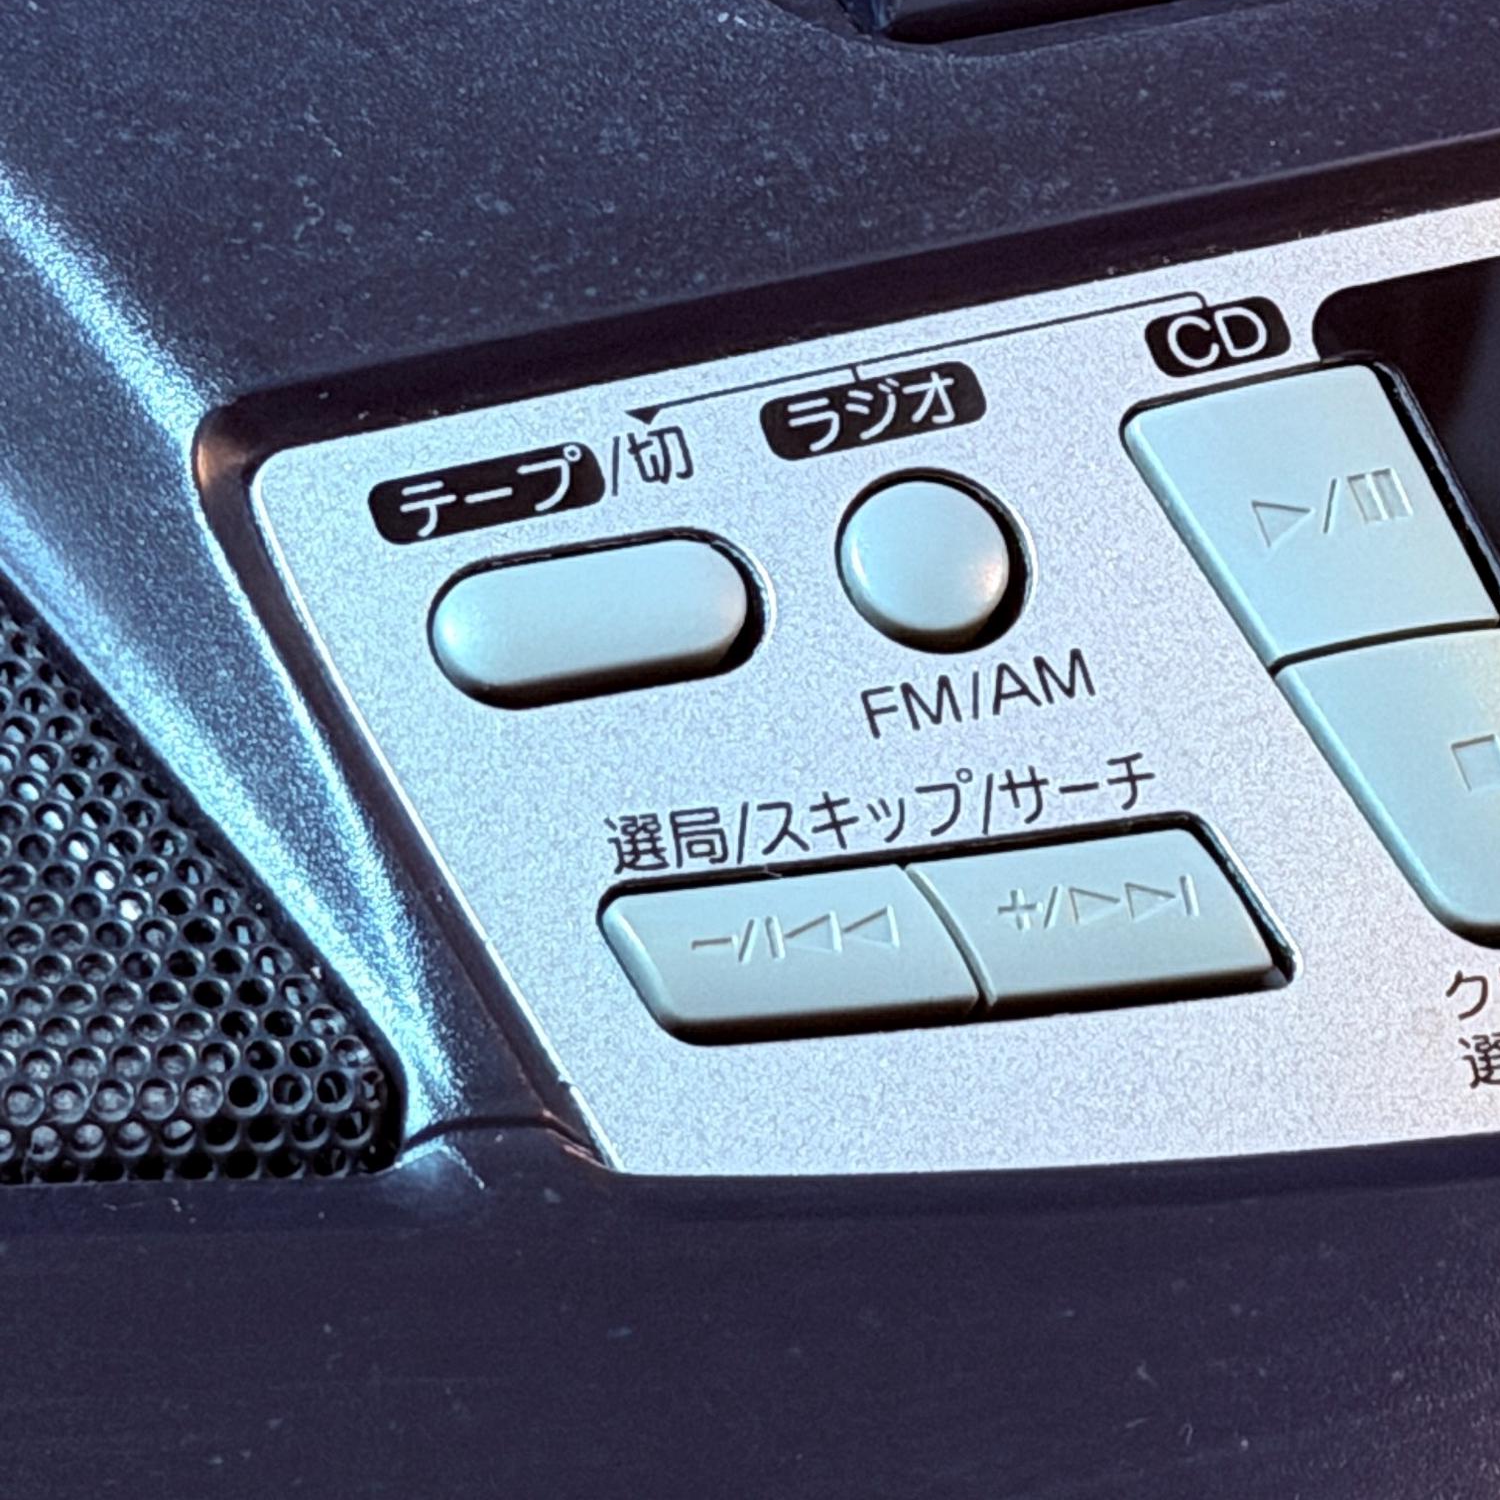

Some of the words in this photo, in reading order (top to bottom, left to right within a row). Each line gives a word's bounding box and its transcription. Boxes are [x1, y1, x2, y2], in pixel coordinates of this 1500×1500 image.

[1166, 306, 1268, 367] CD
[787, 371, 957, 452] ラジオ
[860, 647, 1096, 739] FM/AM
[603, 752, 1156, 875] 選局/スキップ/サーチ
